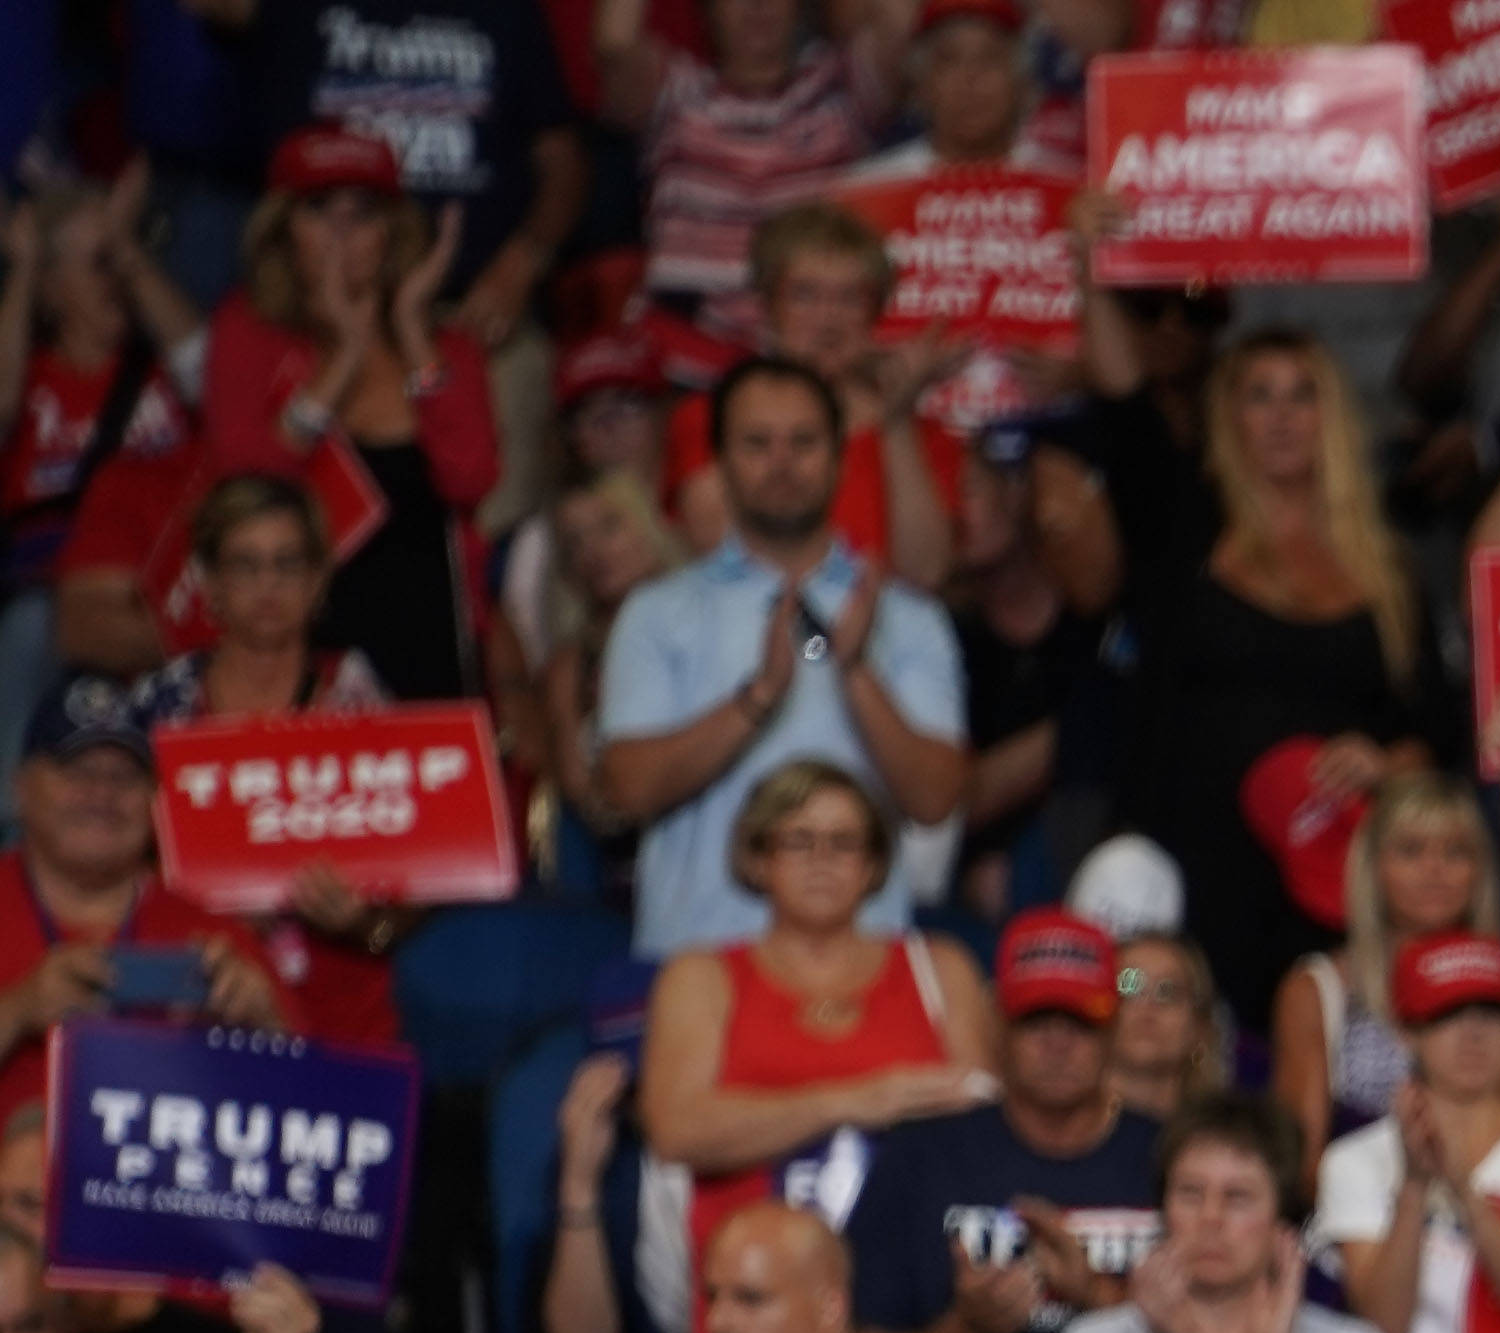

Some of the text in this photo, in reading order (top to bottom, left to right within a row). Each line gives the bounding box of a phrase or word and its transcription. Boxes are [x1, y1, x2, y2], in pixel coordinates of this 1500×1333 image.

[1111, 132, 1400, 192] AMERICA
[174, 743, 472, 809] TRUMP
[246, 798, 416, 845] 2020
[90, 1087, 394, 1172] TRUMP
[115, 1144, 368, 1212] PENCE
